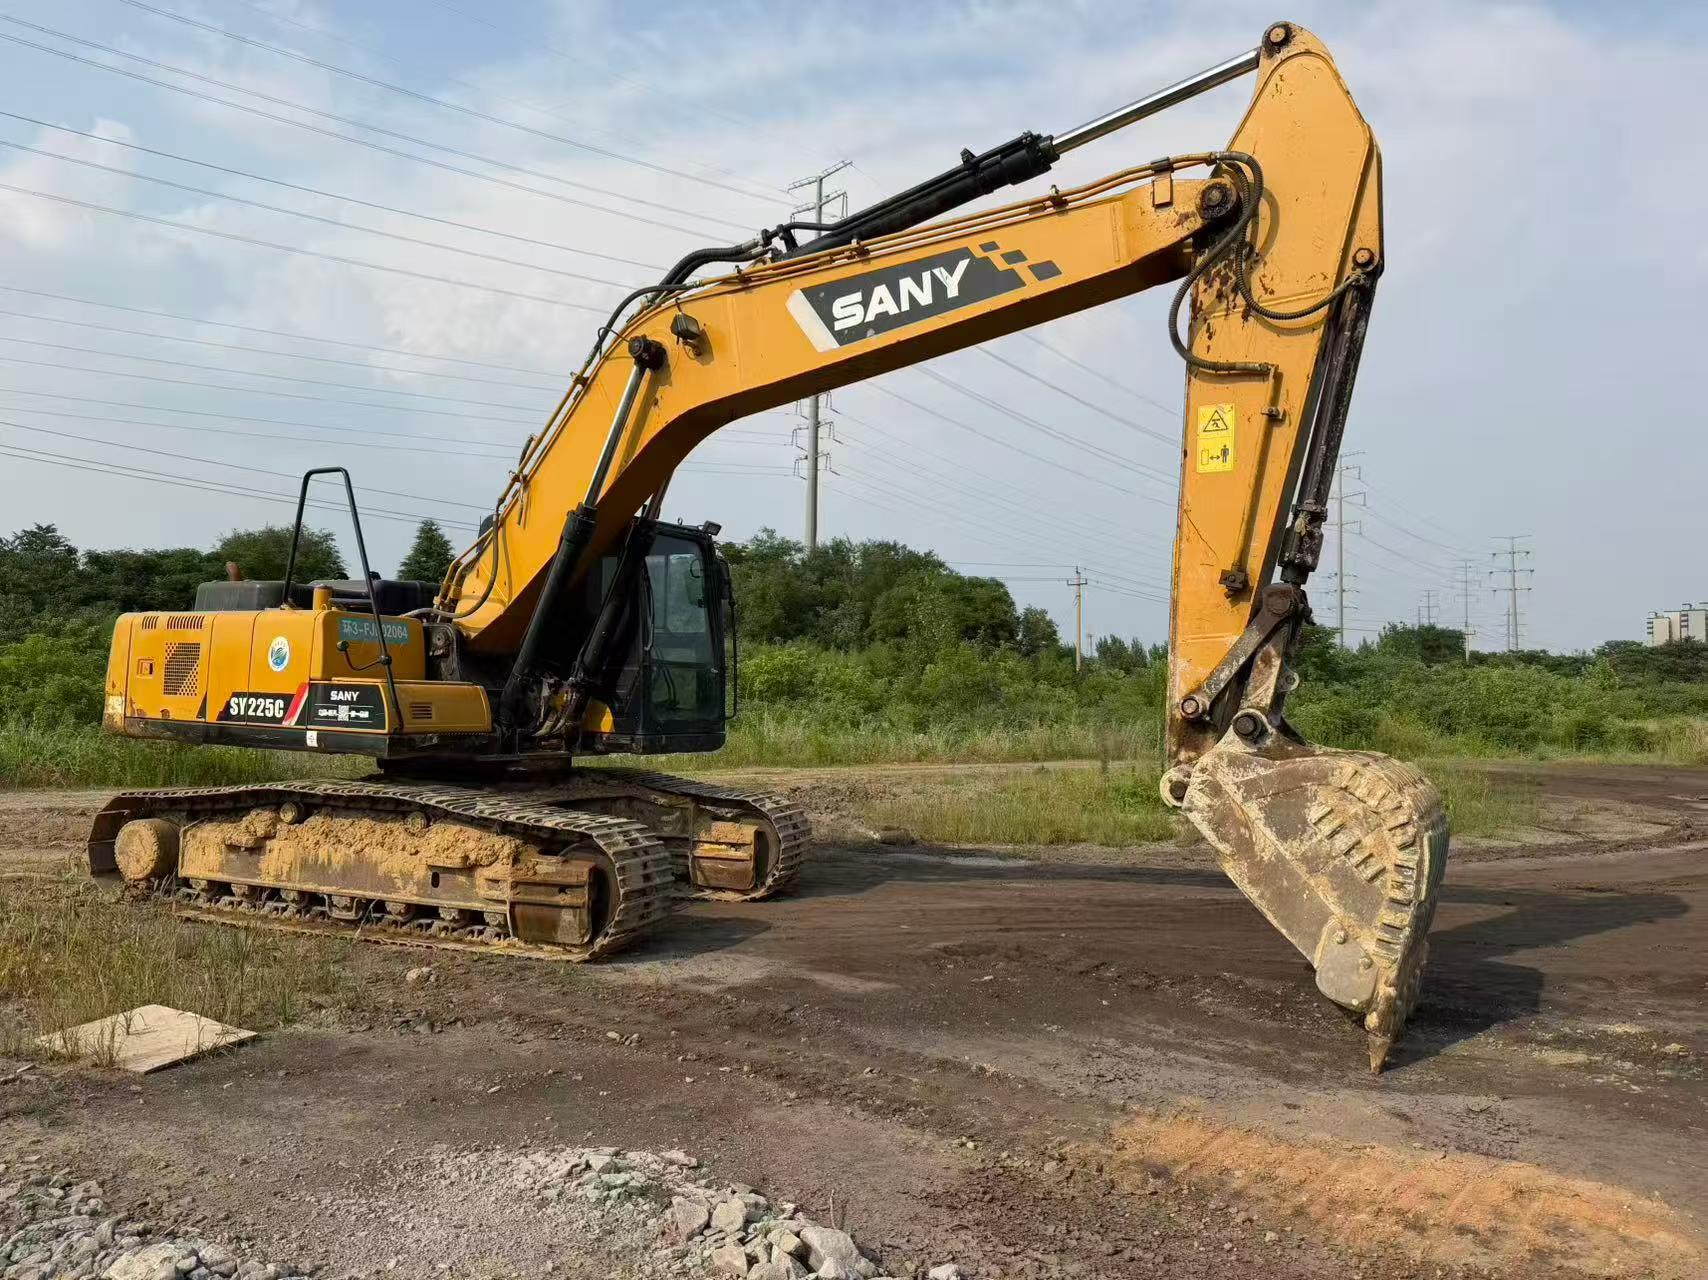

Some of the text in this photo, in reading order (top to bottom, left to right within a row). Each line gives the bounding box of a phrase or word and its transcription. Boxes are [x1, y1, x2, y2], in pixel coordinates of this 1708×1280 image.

[832, 258, 970, 331] SANY
[342, 619, 408, 639] 环3-FJ02064
[330, 691, 360, 701] SANY
[229, 697, 284, 718] SY225C
